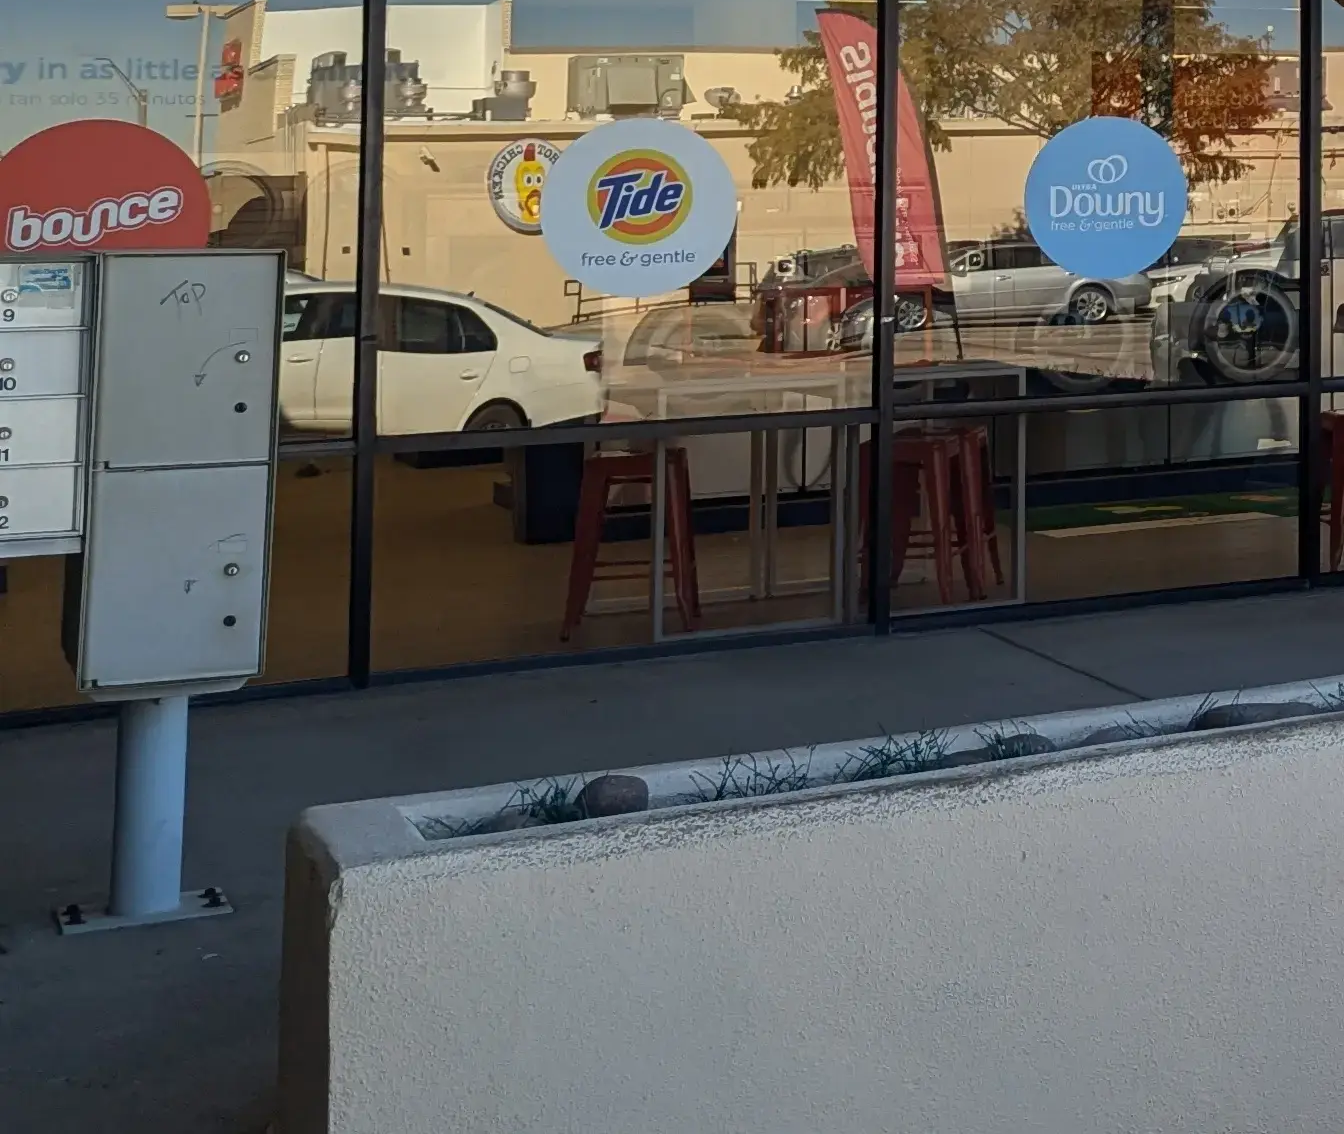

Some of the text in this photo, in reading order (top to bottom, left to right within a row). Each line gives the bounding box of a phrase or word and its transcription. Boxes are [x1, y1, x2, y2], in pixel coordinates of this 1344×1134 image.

[38, 57, 67, 81] in
[80, 60, 113, 81] as
[126, 57, 198, 81] little
[597, 169, 686, 230] Tide
[1050, 185, 1165, 227] Downy
[6, 186, 184, 252] bounce
[1051, 220, 1076, 231] free
[1095, 219, 1134, 232] gentle
[581, 250, 696, 267] free & gentle
[3, 310, 15, 322] 9
